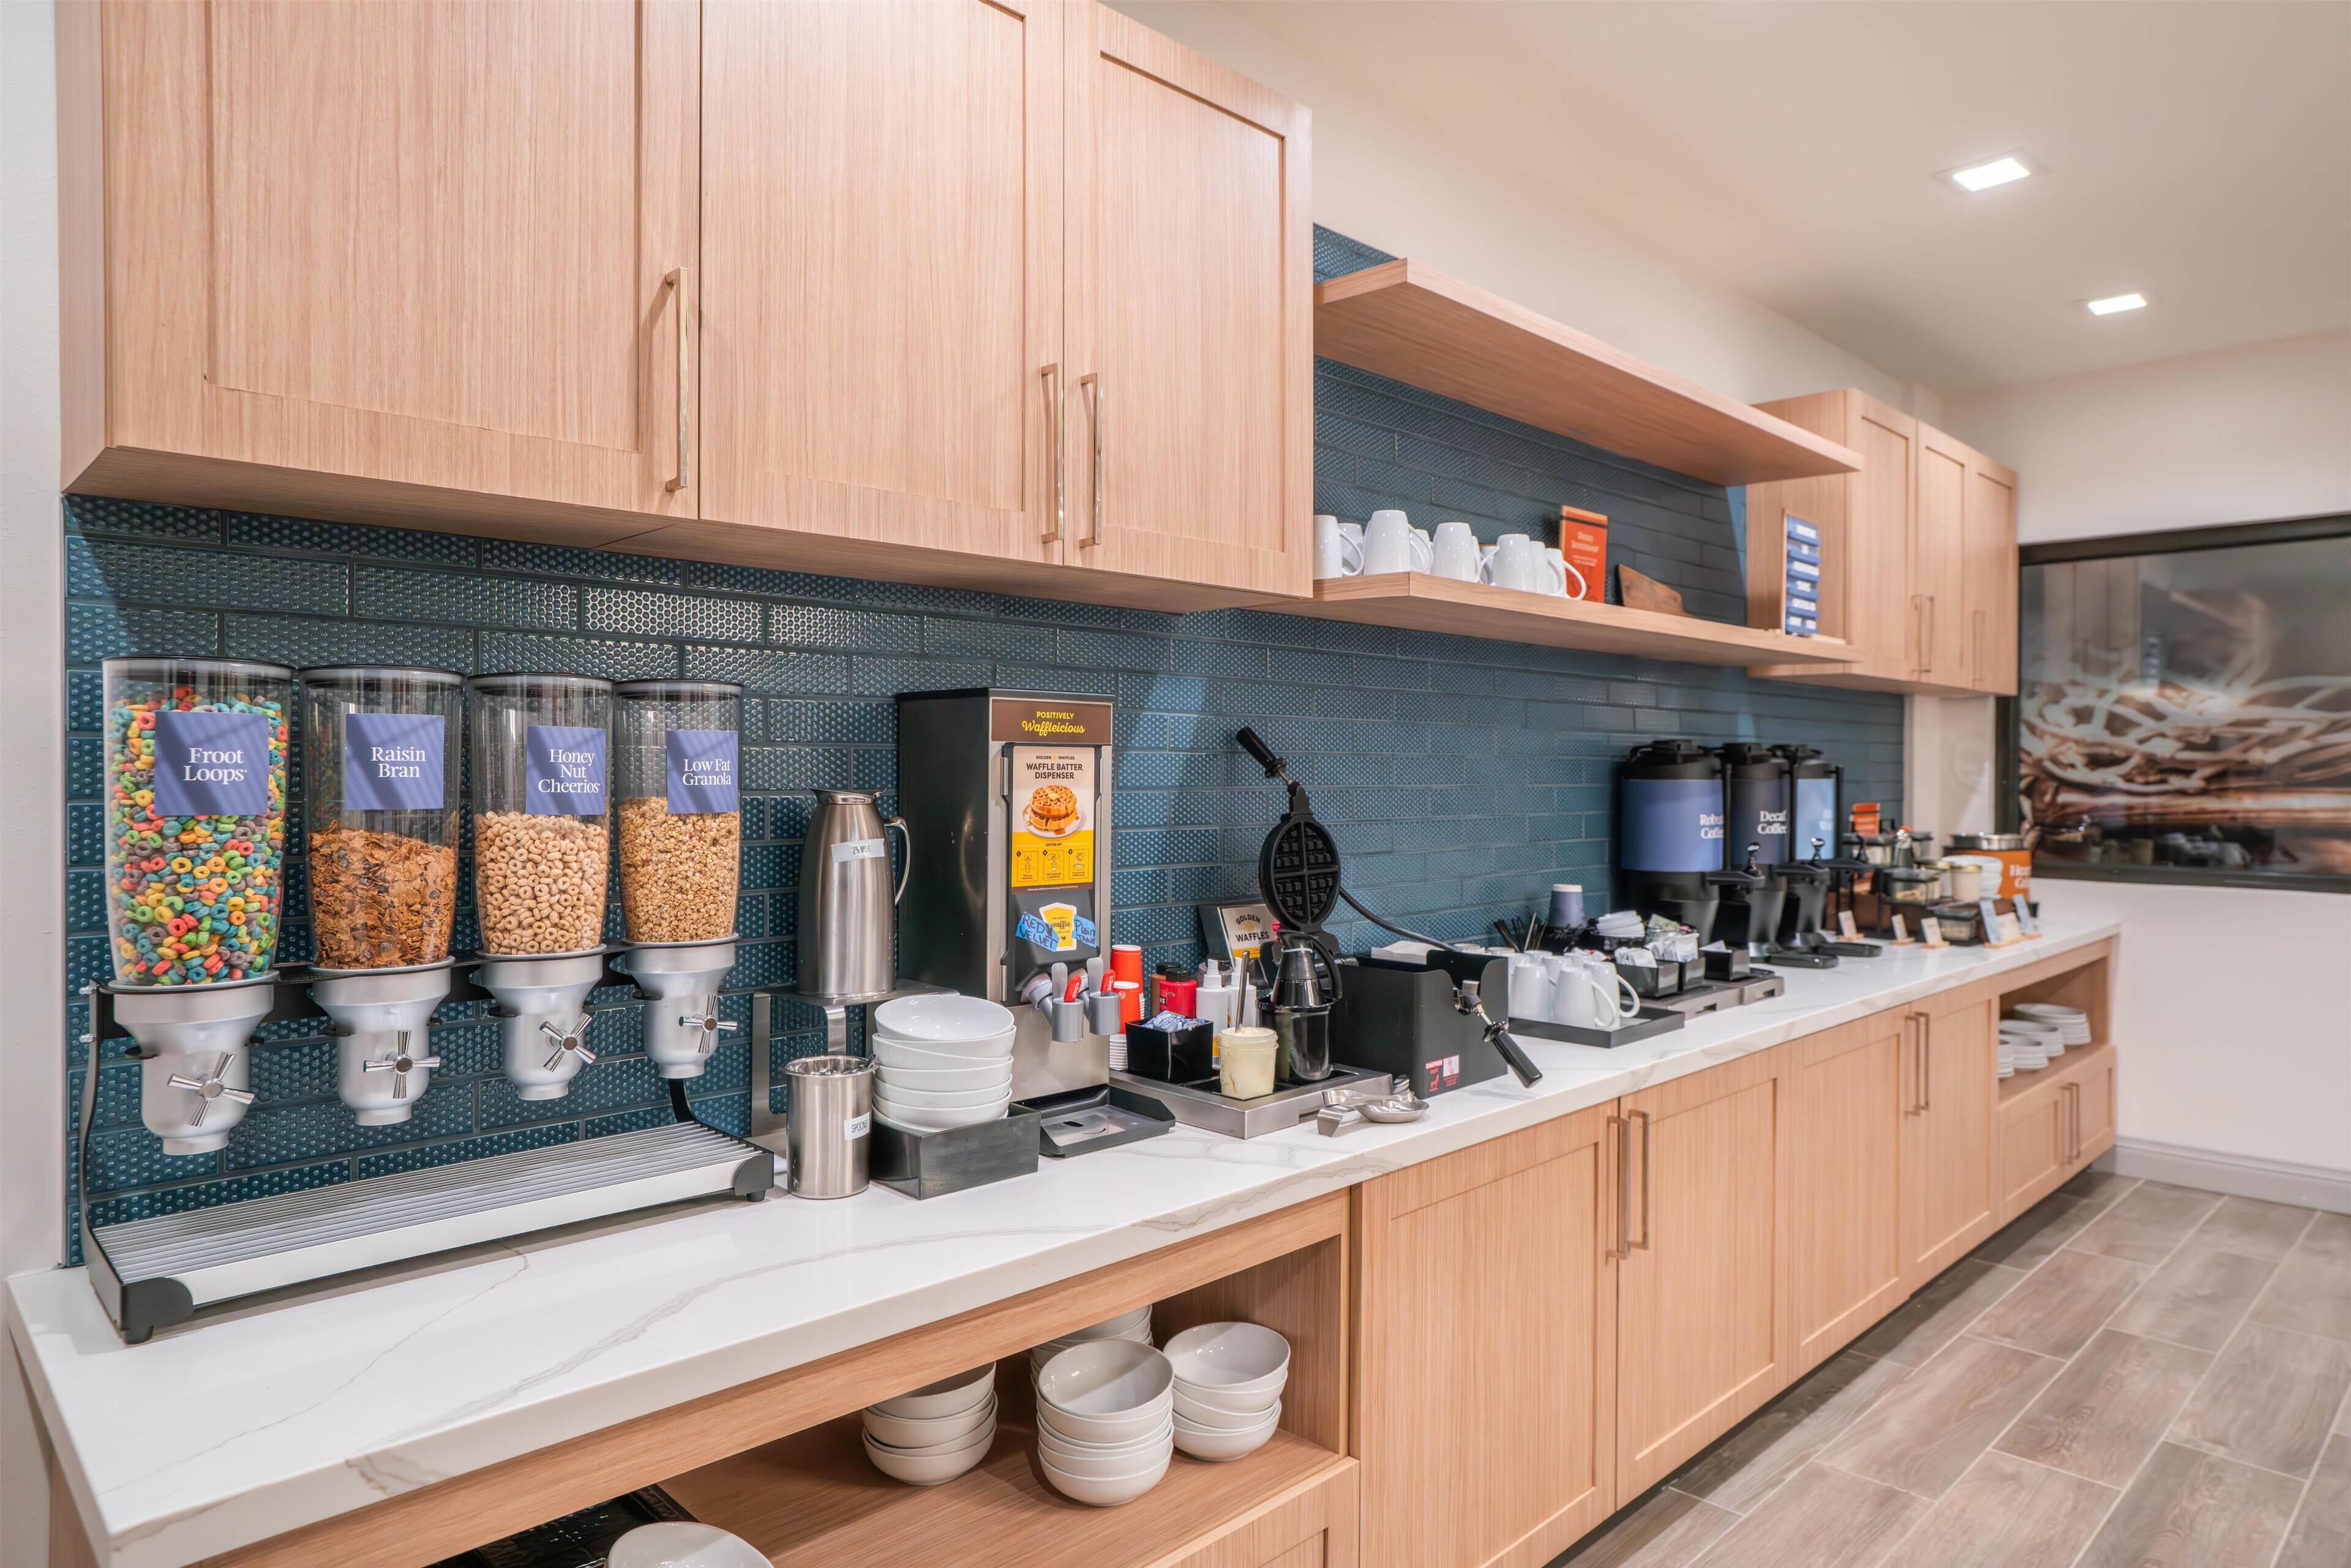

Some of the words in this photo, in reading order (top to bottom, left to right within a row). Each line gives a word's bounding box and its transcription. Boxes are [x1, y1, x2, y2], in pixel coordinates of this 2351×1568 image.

[1037, 711, 1074, 719] POSITIVELY
[1021, 720, 1086, 737] Waffleicious
[189, 748, 244, 764] Froot
[370, 746, 426, 762] Raisin
[549, 749, 595, 767] Honey
[377, 763, 421, 778] Bran
[560, 765, 587, 778] Nut
[683, 759, 713, 771] Low
[714, 759, 731, 771] Fat
[183, 765, 246, 785] Loops
[682, 773, 732, 786] Granola
[538, 779, 599, 793] Cheerios
[1760, 810, 1787, 822] Decaf
[1757, 822, 1788, 835] Coffee
[1022, 913, 1045, 934] RED
[1236, 914, 1260, 925] GOLDEN
[1074, 919, 1095, 937] Plain
[1020, 925, 1058, 949] VELVET
[1235, 931, 1269, 942] WAFFLES
[852, 1119, 867, 1133] SPOONS
